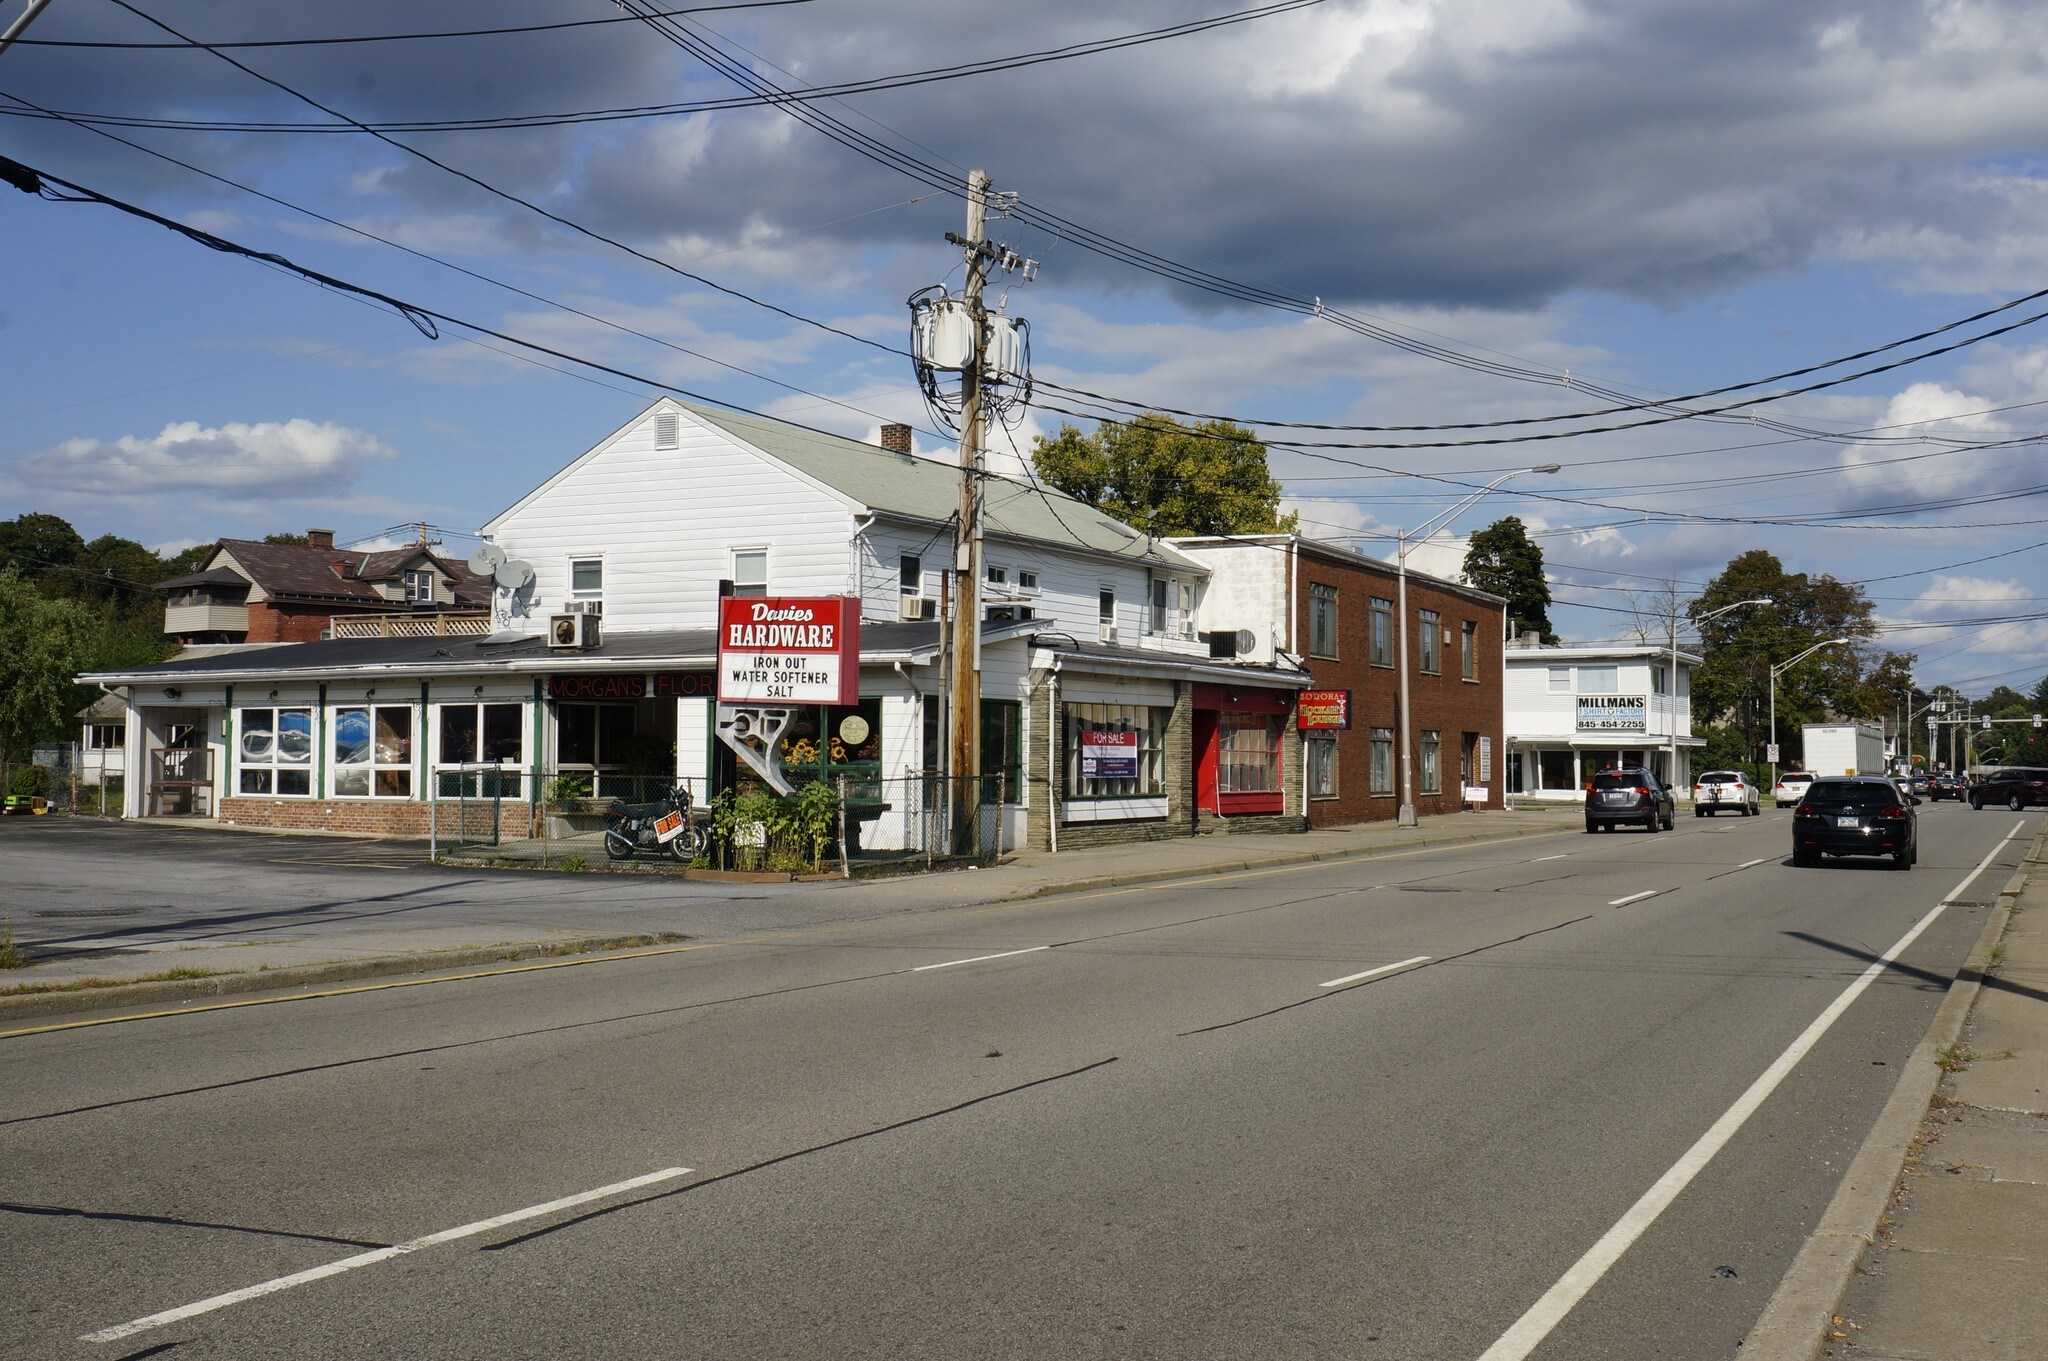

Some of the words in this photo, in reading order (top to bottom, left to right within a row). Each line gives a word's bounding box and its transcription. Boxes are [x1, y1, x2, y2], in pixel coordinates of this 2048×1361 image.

[751, 603, 814, 622] Davies
[729, 624, 834, 648] HARDWARE
[754, 657, 779, 669] IRON
[785, 657, 807, 669] OUT
[732, 670, 768, 682] WATER
[774, 671, 828, 684] SOFTENER
[550, 677, 643, 697] MORGAN'S
[767, 685, 794, 697] SALT
[1300, 705, 1340, 716] HOOKAH
[1578, 720, 1645, 728] 845-454-2255
[1093, 732, 1107, 744] FOR
[1107, 732, 1124, 744] SALE
[667, 812, 681, 830] SALE
